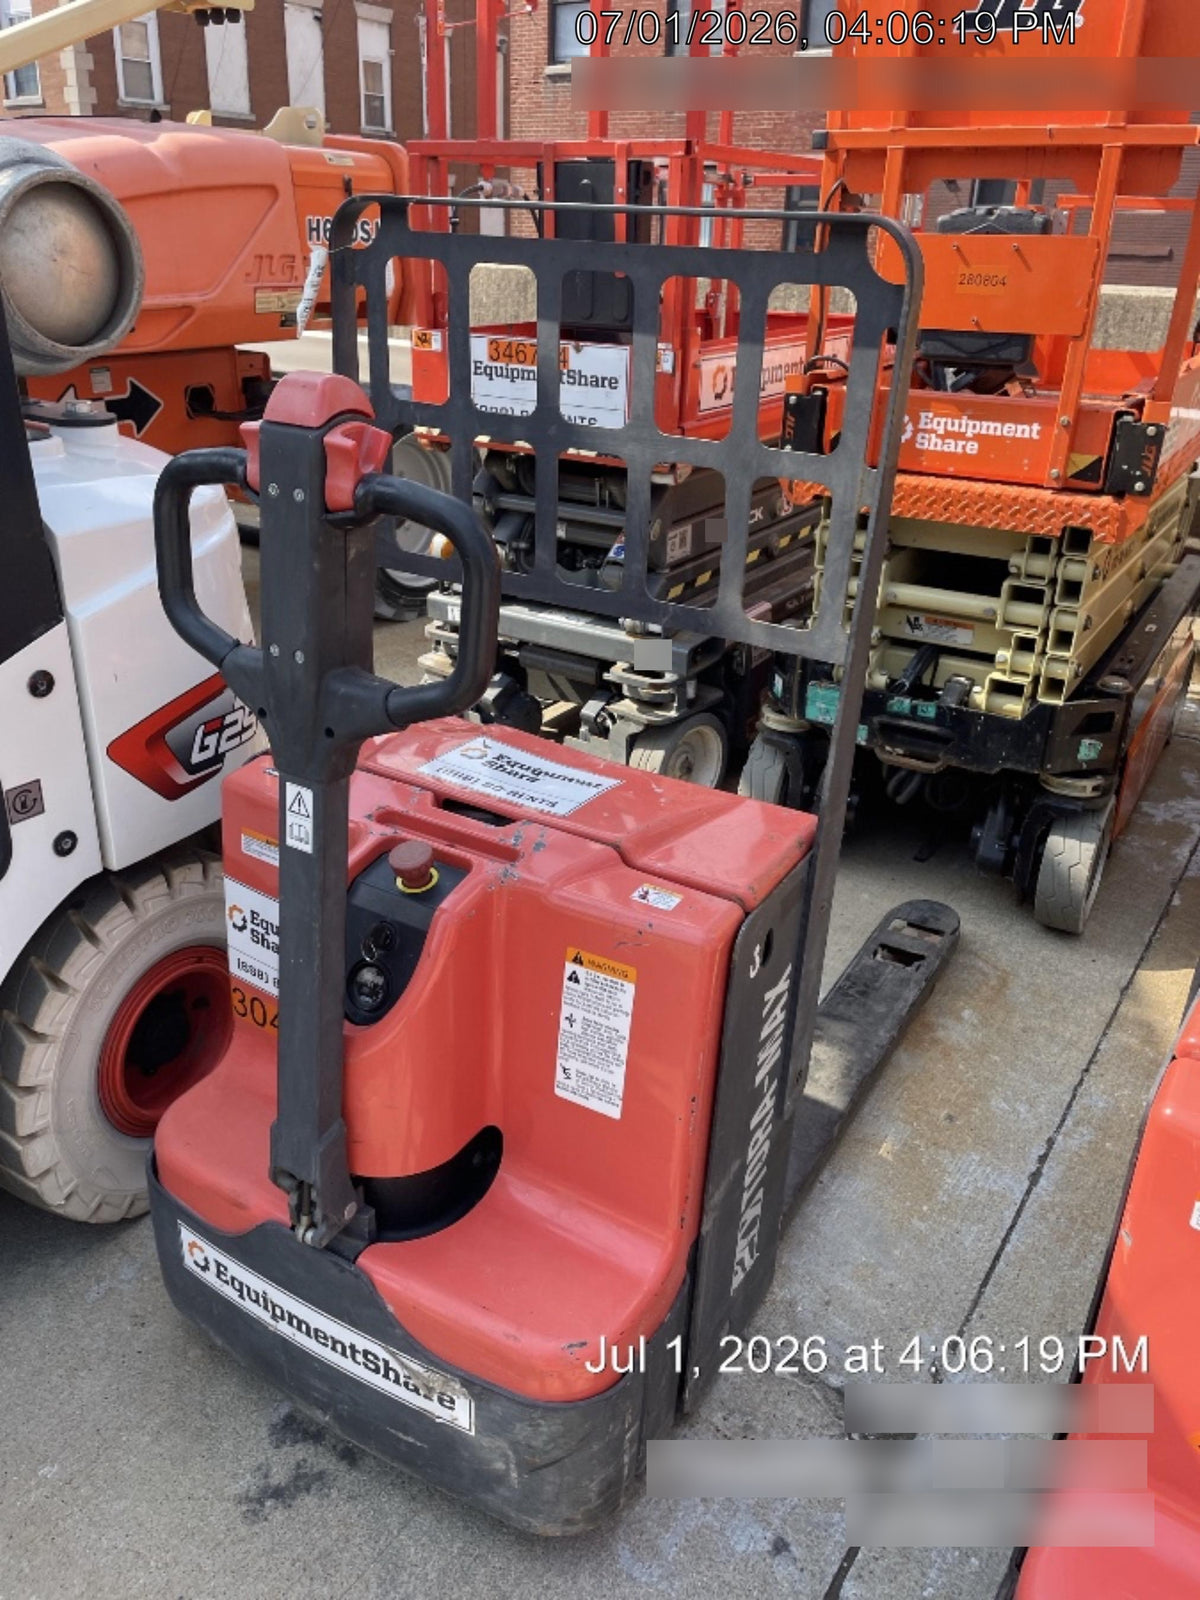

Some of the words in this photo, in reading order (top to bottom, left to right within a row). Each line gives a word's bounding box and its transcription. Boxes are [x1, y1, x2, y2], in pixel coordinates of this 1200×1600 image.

[918, 411, 1041, 440] Equipment
[915, 432, 979, 455] Share
[250, 927, 280, 955] Sha
